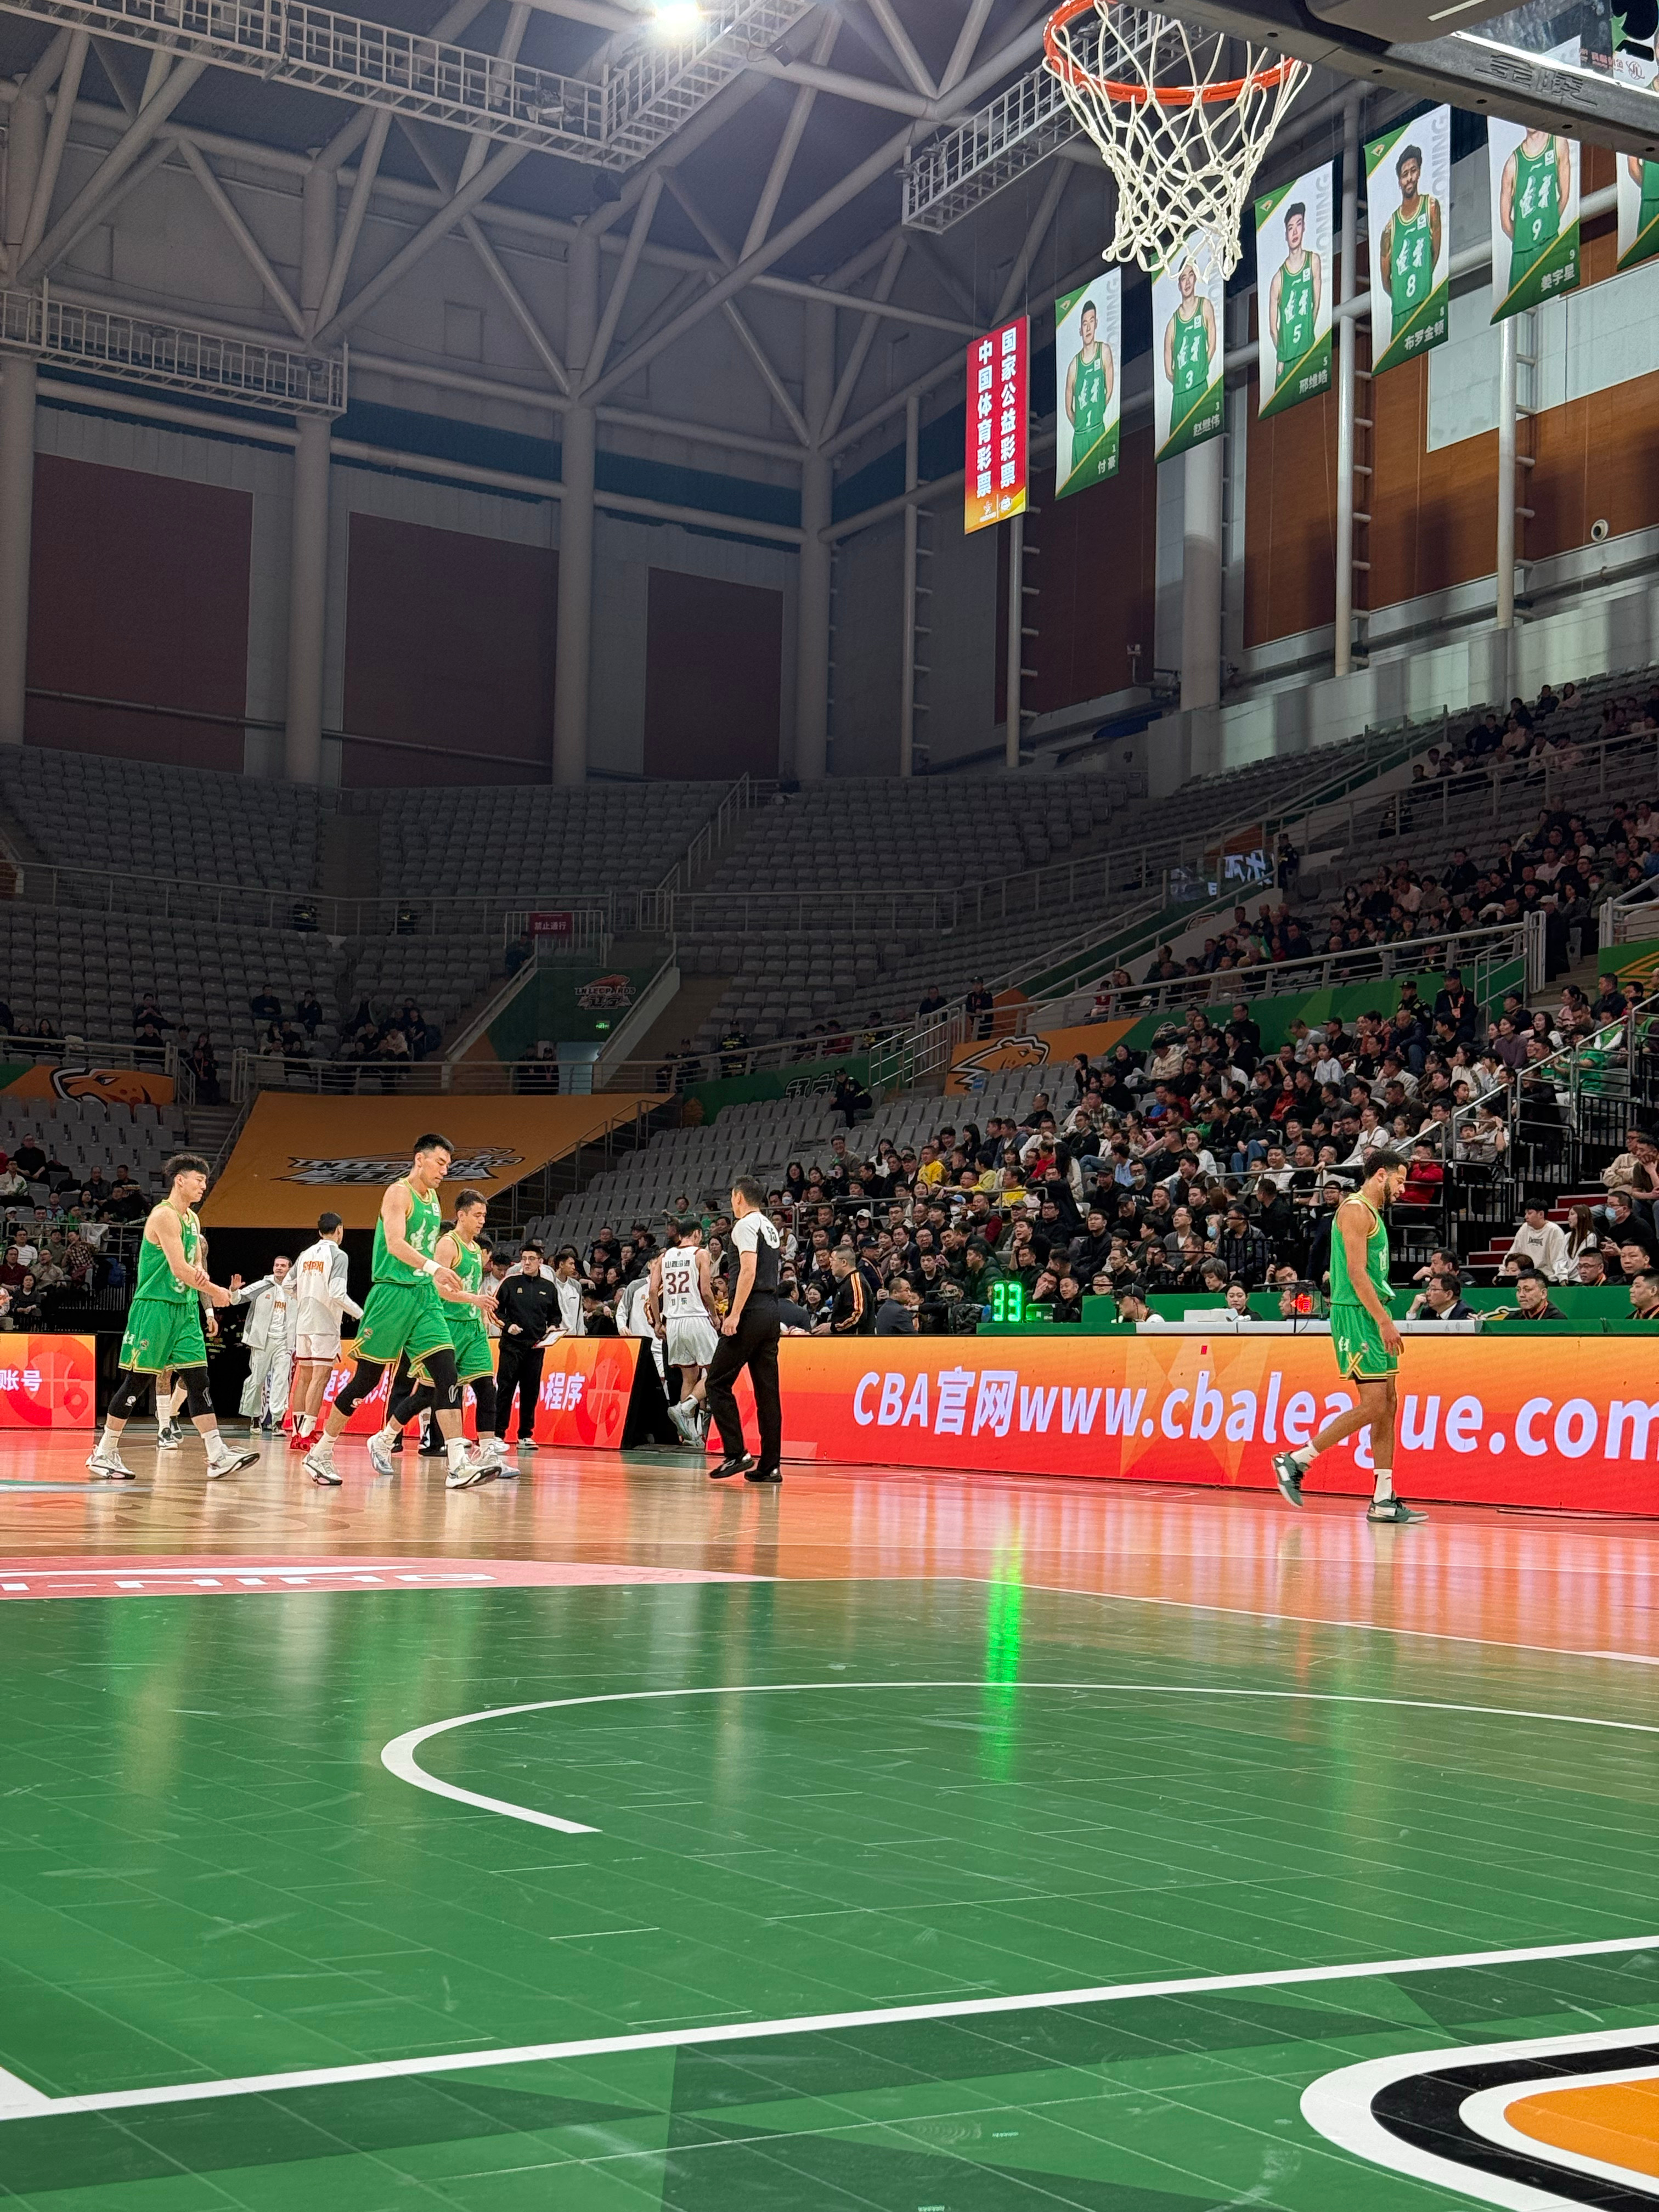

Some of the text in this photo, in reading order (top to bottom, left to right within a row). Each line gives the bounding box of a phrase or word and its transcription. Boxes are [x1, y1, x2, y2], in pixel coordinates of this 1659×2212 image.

[1532, 218, 1542, 241] 9
[1569, 249, 1576, 260] 9
[1406, 274, 1415, 297] 8
[1440, 306, 1444, 317] 8
[1292, 324, 1302, 344] 5
[1323, 356, 1328, 366] 5
[1185, 369, 1194, 389] 3
[1000, 326, 1017, 490] 国家公益彩票
[1215, 401, 1220, 411] 3
[976, 340, 992, 499] 中国体育彩票
[1086, 415, 1091, 427] 1
[1111, 443, 1116, 453] 1
[1097, 454, 1116, 475] 付豪
[534, 921, 567, 930] 禁止通行
[345, 1158, 517, 1170] LEORDS
[665, 1271, 691, 1295] 32
[994, 1283, 1022, 1322] 33
[0, 1369, 43, 1392] 账号
